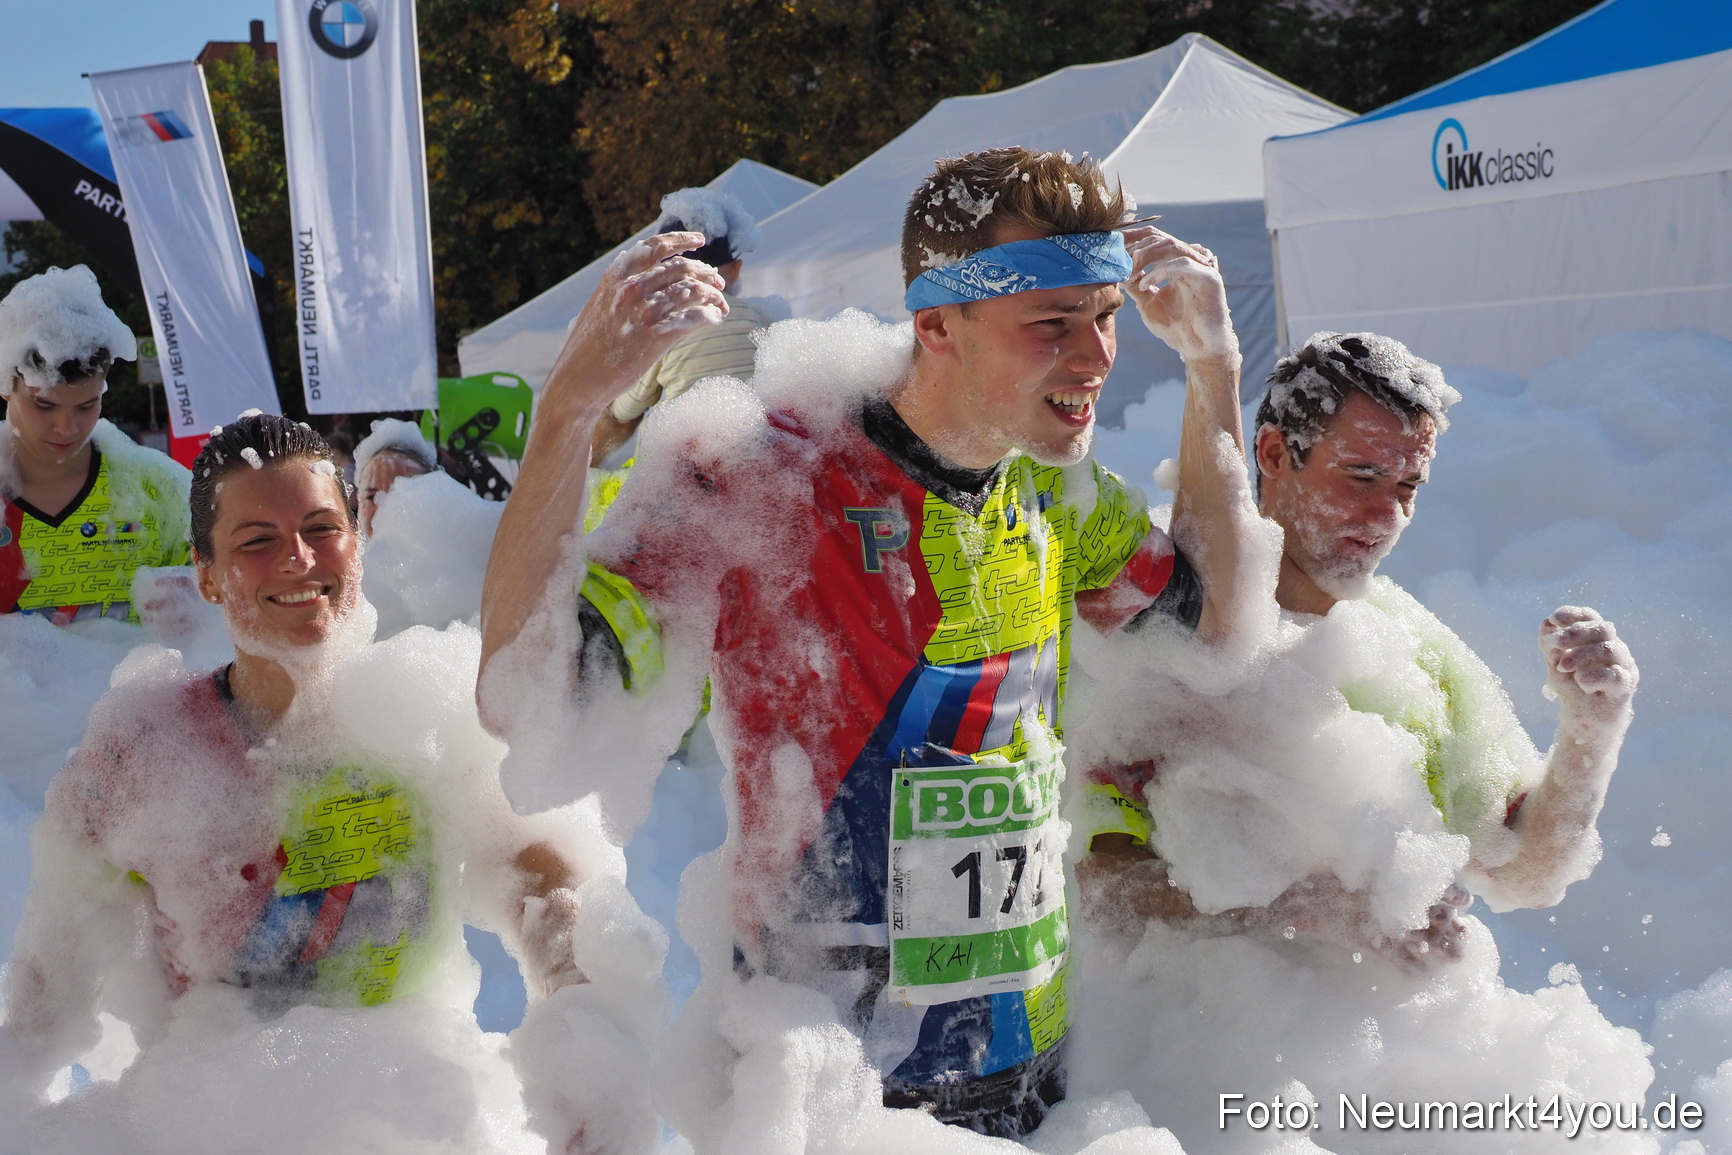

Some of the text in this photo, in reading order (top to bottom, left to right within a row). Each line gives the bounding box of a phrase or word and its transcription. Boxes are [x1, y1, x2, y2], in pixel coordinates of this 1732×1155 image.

[1485, 141, 1554, 185] classic
[74, 179, 128, 223] PART
[926, 942, 973, 972] KAI
